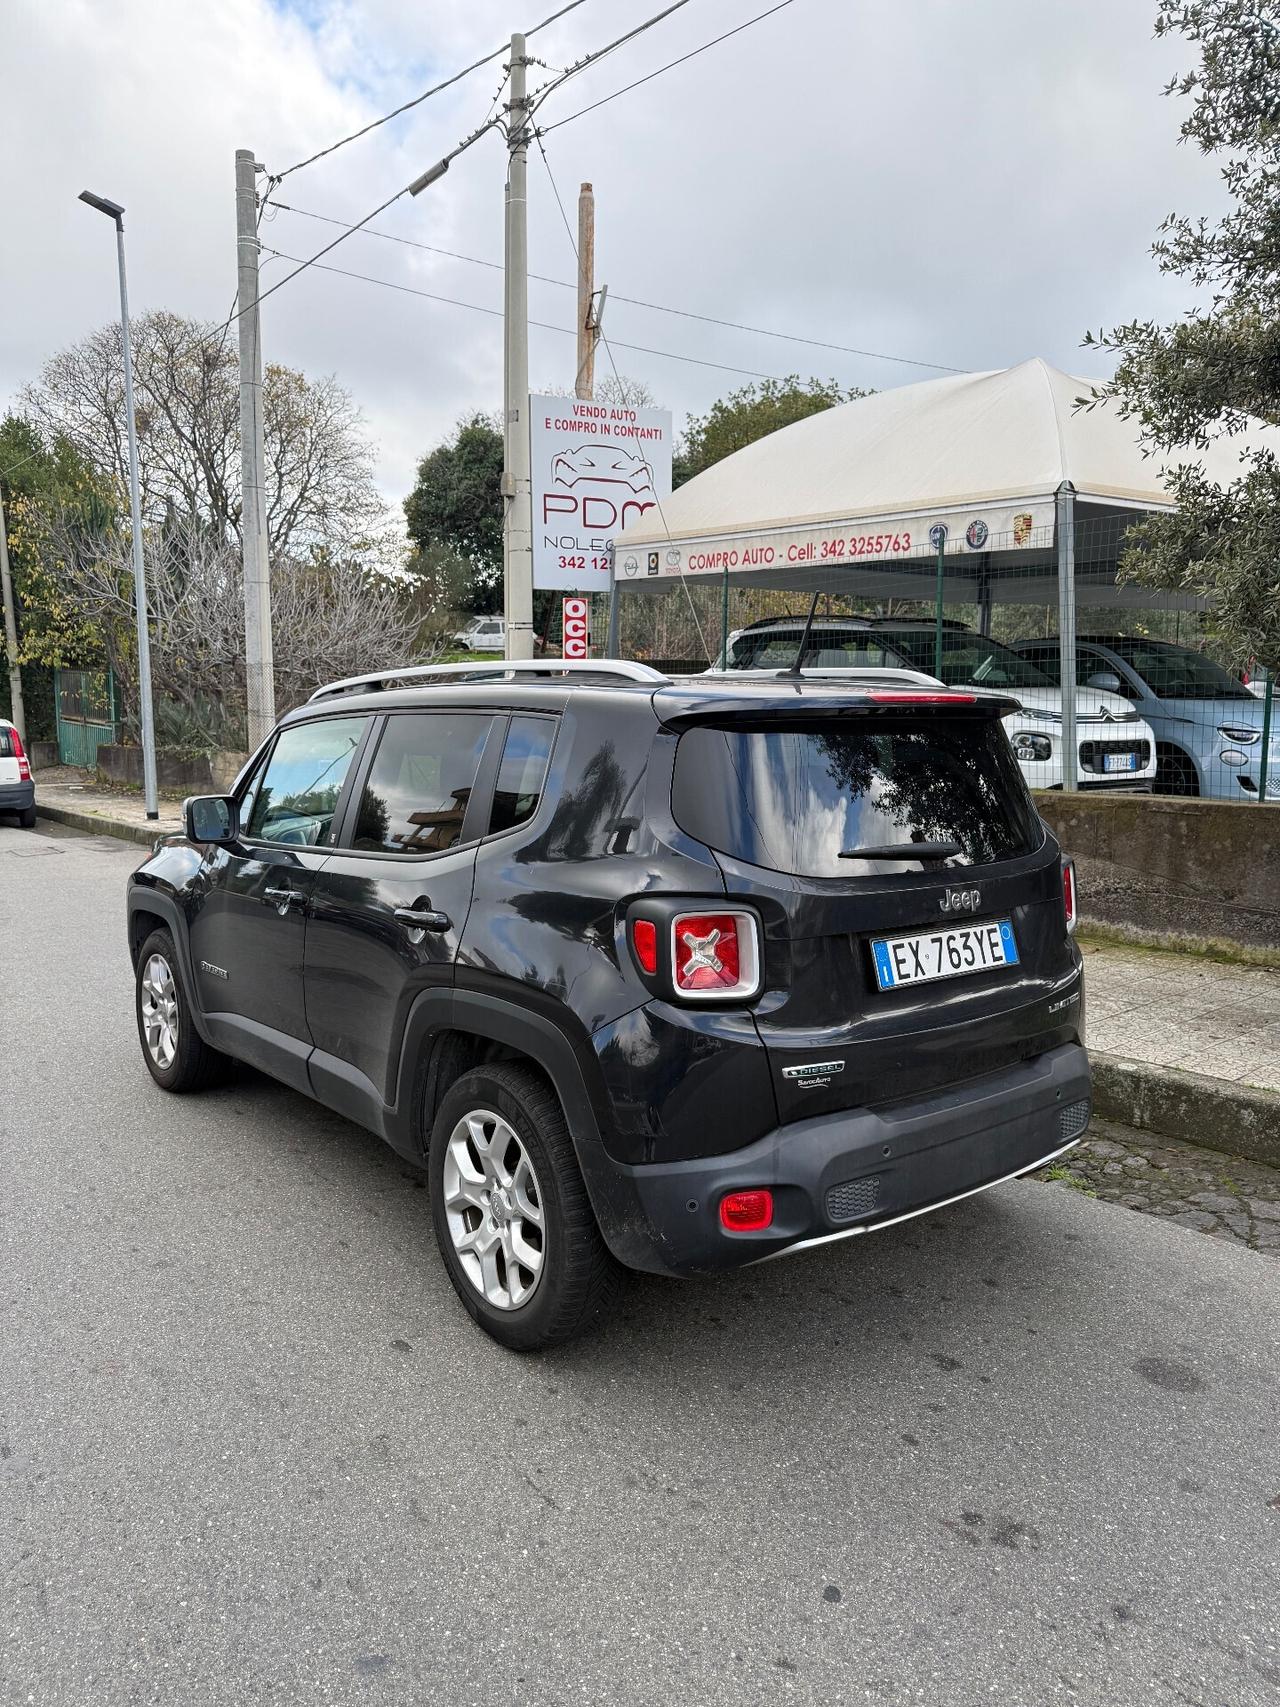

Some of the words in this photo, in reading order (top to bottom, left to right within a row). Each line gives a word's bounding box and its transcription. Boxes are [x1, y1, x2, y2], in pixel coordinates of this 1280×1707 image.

[573, 405, 607, 419] VENDO
[610, 409, 636, 422] AUTO
[545, 417, 552, 429] E
[554, 419, 598, 434] COMPRO
[600, 424, 610, 435] IN
[613, 425, 662, 441] CONTANTI
[558, 555, 585, 569] 342
[689, 550, 739, 570] COMPRO
[742, 546, 775, 565] AUTO
[788, 542, 817, 561] Cell:
[821, 539, 845, 558] 342
[849, 533, 911, 556] 3255763
[940, 889, 981, 912] Jeep
[892, 940, 926, 980] EX
[931, 927, 1004, 974] 763YE
[800, 1064, 842, 1075] DIESEL
